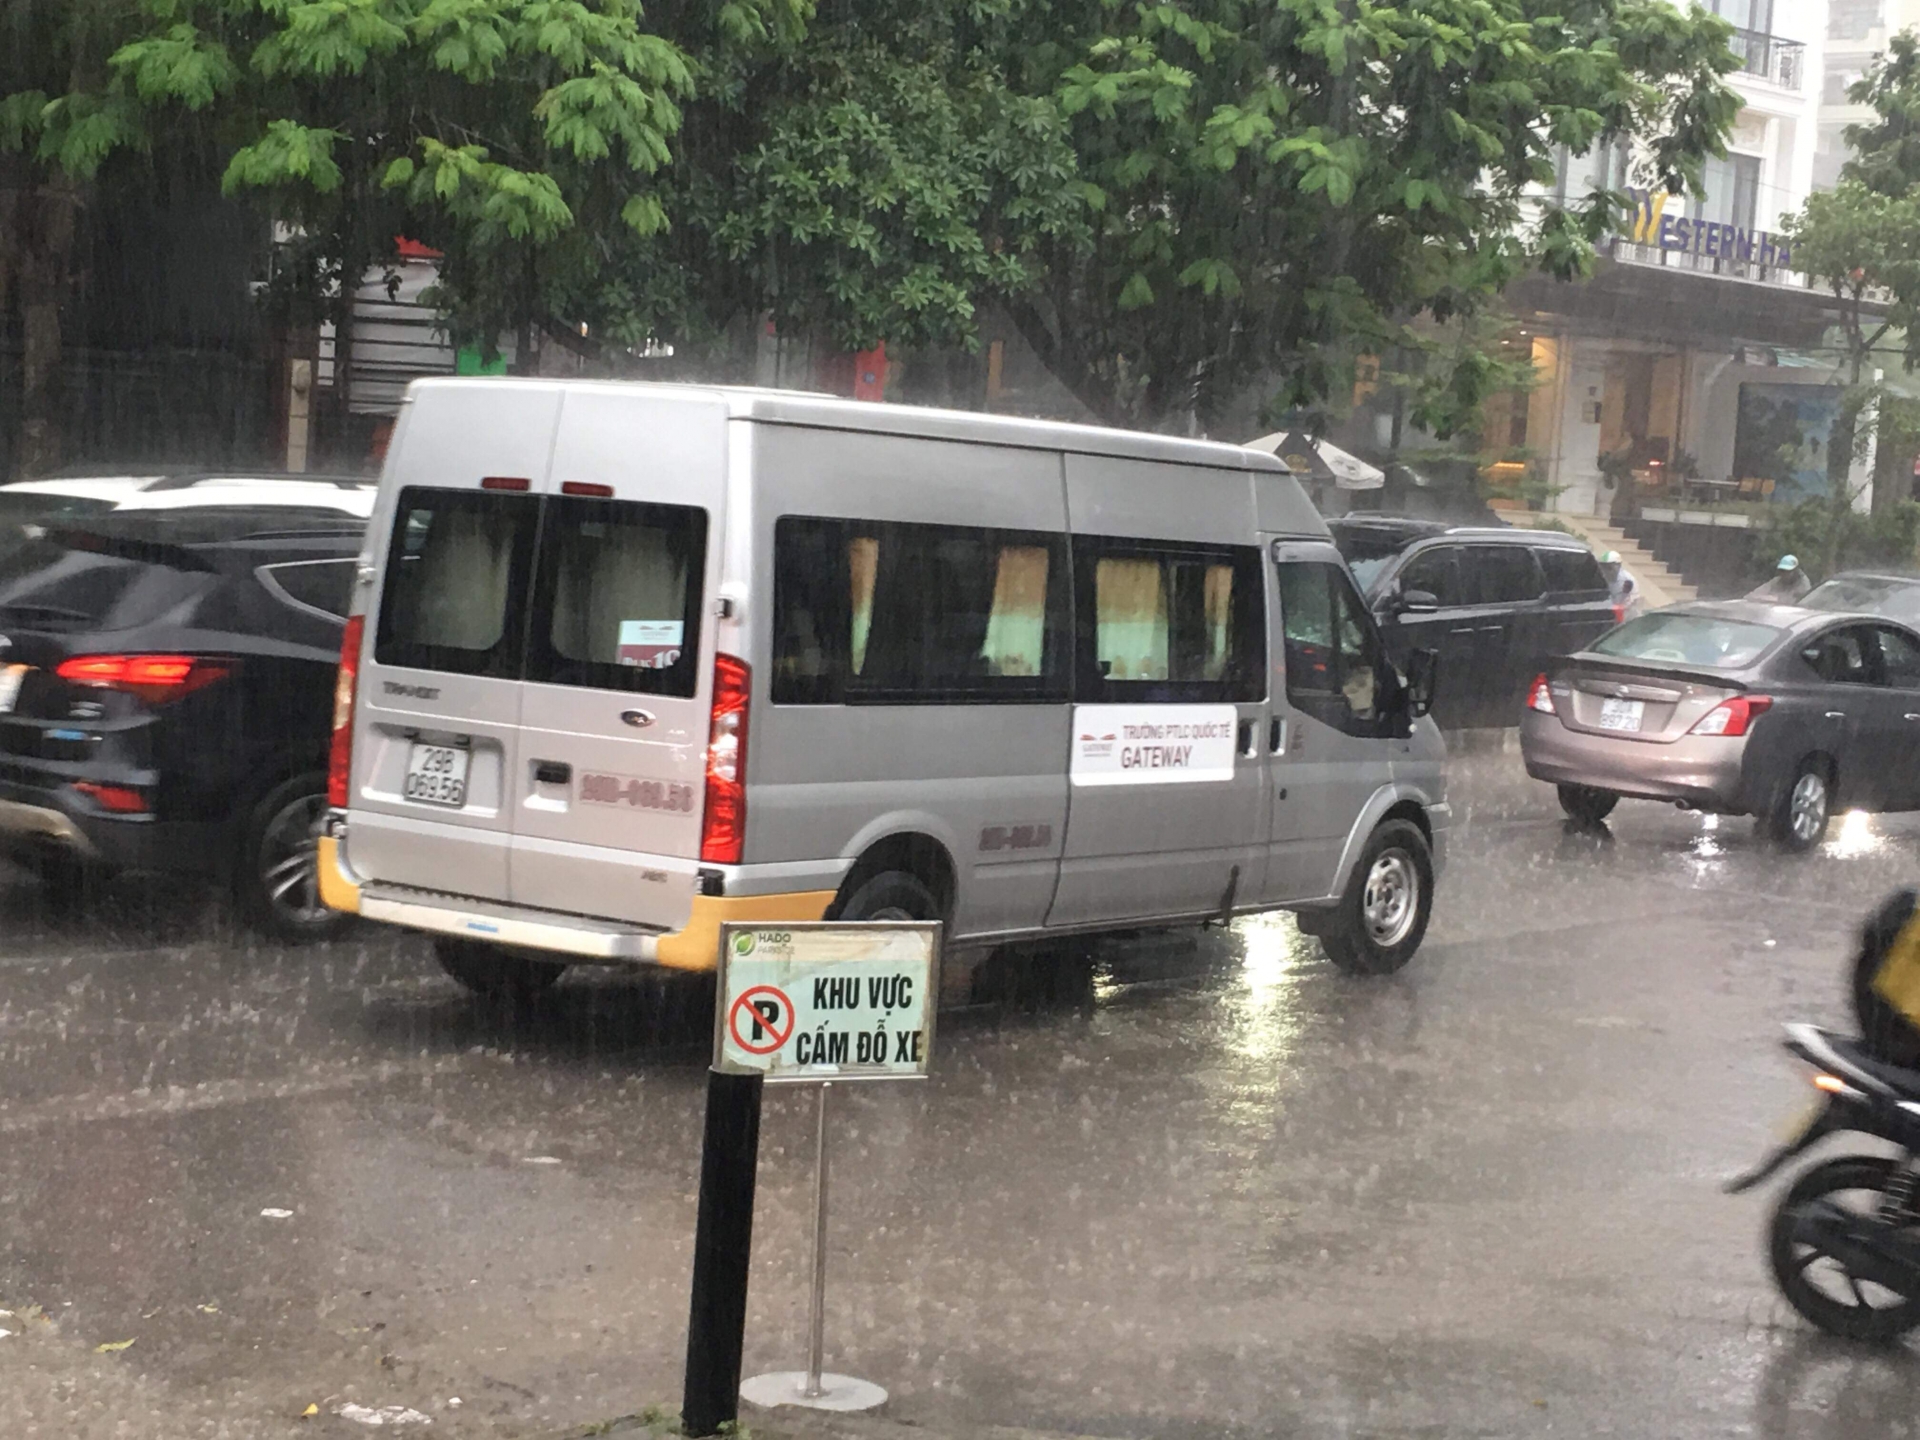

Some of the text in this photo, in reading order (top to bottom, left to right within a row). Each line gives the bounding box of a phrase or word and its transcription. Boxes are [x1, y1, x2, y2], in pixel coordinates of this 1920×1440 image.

[1121, 745, 1192, 768] GATEWAY
[813, 973, 913, 1016] KHU VỰC
[796, 1019, 923, 1065] CẤM ĐỖ XE
